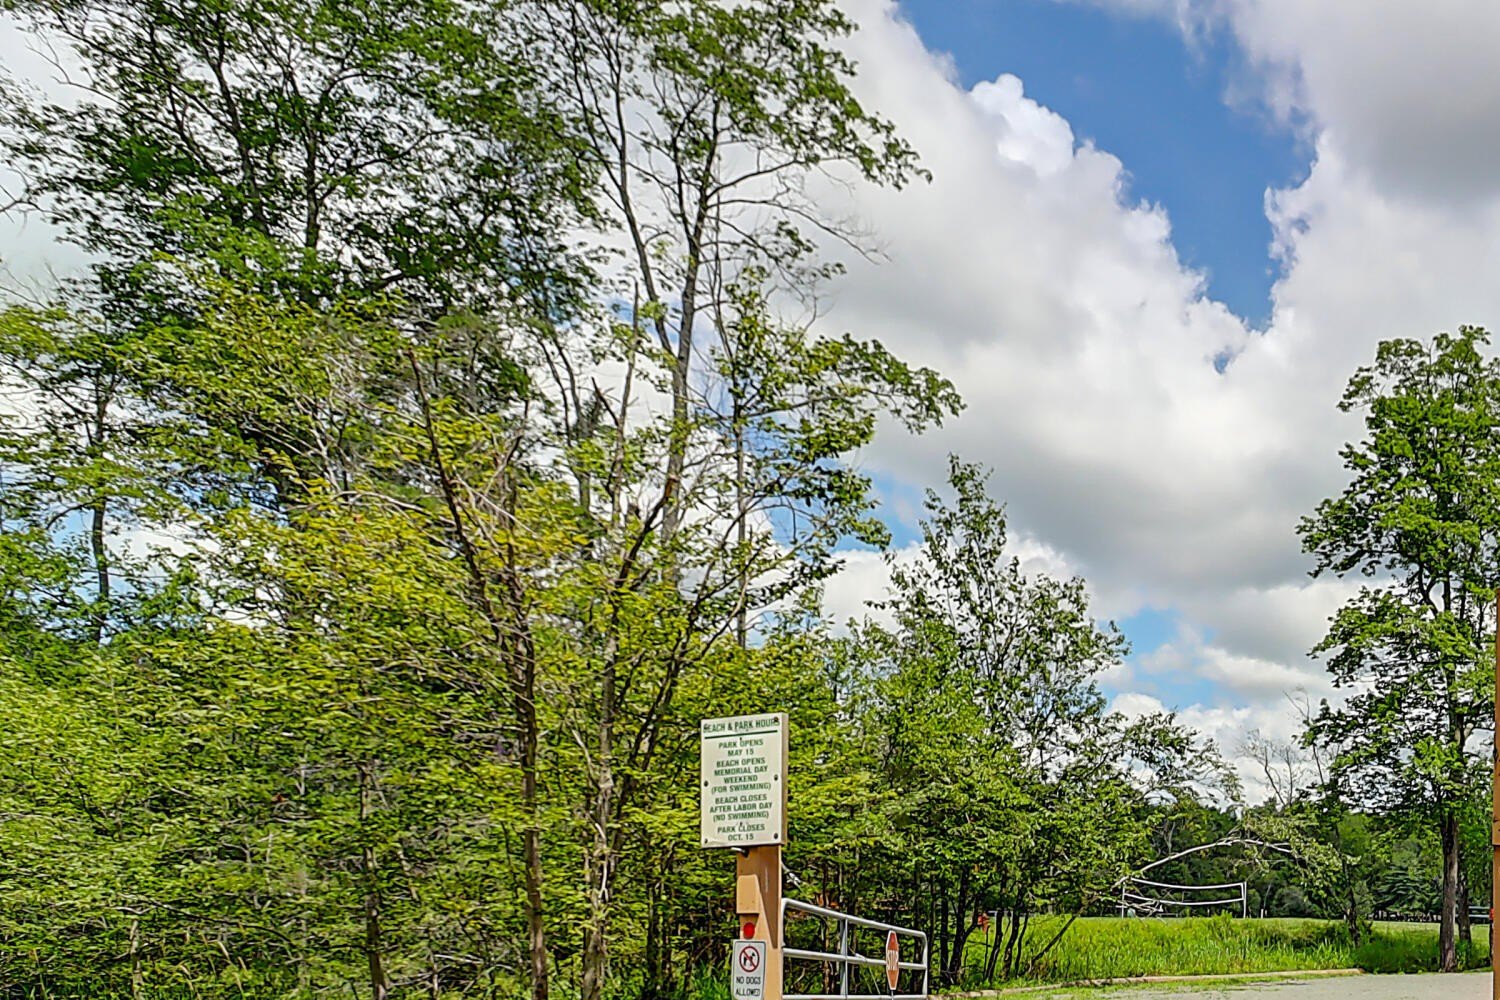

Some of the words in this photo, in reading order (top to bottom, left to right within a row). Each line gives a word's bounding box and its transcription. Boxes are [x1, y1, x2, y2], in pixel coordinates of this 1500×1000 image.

[728, 722, 733, 730] &
[734, 720, 753, 730] PARK
[718, 741, 737, 749] PARK
[740, 738, 764, 747] OPENS
[716, 760, 739, 768] BEACH
[741, 757, 765, 765] OPENS
[714, 766, 752, 776] MEMORIAL
[724, 775, 758, 784] WEEKEND
[712, 786, 727, 794] (FOR
[730, 782, 771, 792] SWIMMING)
[715, 796, 738, 804] BEACH
[740, 794, 767, 802] CLOSES
[710, 805, 732, 813] AFTER
[713, 814, 725, 822] (NO
[728, 811, 769, 820] SWIMMING)
[738, 824, 765, 832] CLOSES
[736, 976, 744, 984] NO
[736, 988, 760, 996] ALLOWED
